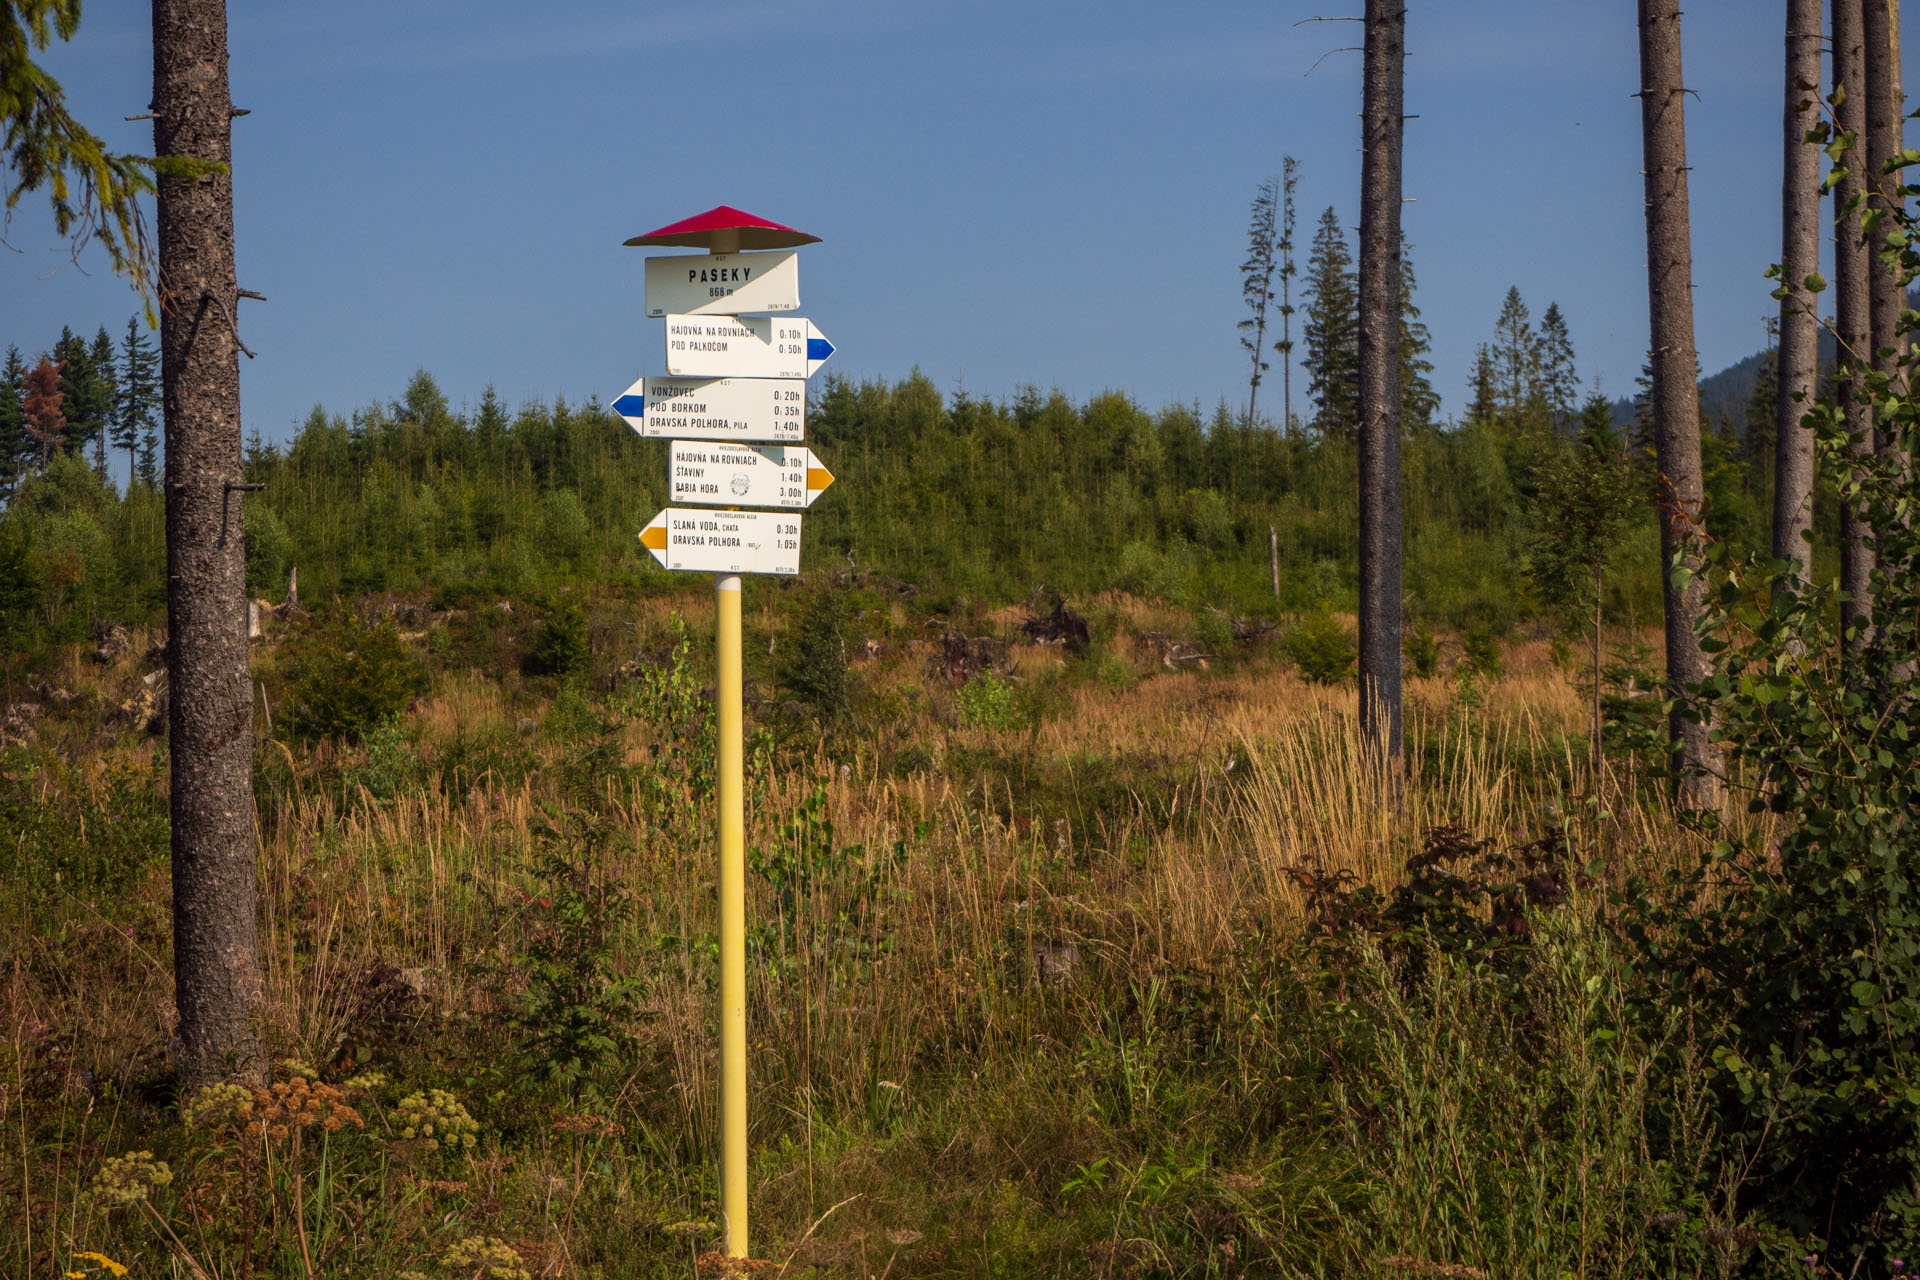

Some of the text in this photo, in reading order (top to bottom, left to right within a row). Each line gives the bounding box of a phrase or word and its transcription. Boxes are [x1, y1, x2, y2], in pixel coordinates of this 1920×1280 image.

[689, 267, 750, 283] PASEKY
[709, 287, 734, 297] 868 m
[671, 324, 755, 338] HÁJOVŇA NA ROVNIACH
[671, 340, 728, 352] POD PALKOČOM
[651, 386, 695, 398] VONŽOVEC
[650, 402, 707, 413] POD BORKOM
[650, 416, 688, 428] ORAVSKÁ
[690, 418, 732, 430] POLHORA,
[676, 451, 757, 466] HÁJOVŇA NA ROVNIACH
[676, 482, 719, 494] BABIA HORA
[673, 519, 739, 532] SLANÁ VODA, CHATA
[673, 534, 705, 546] ORAVSKÁ
[708, 536, 741, 547] POLHORA
